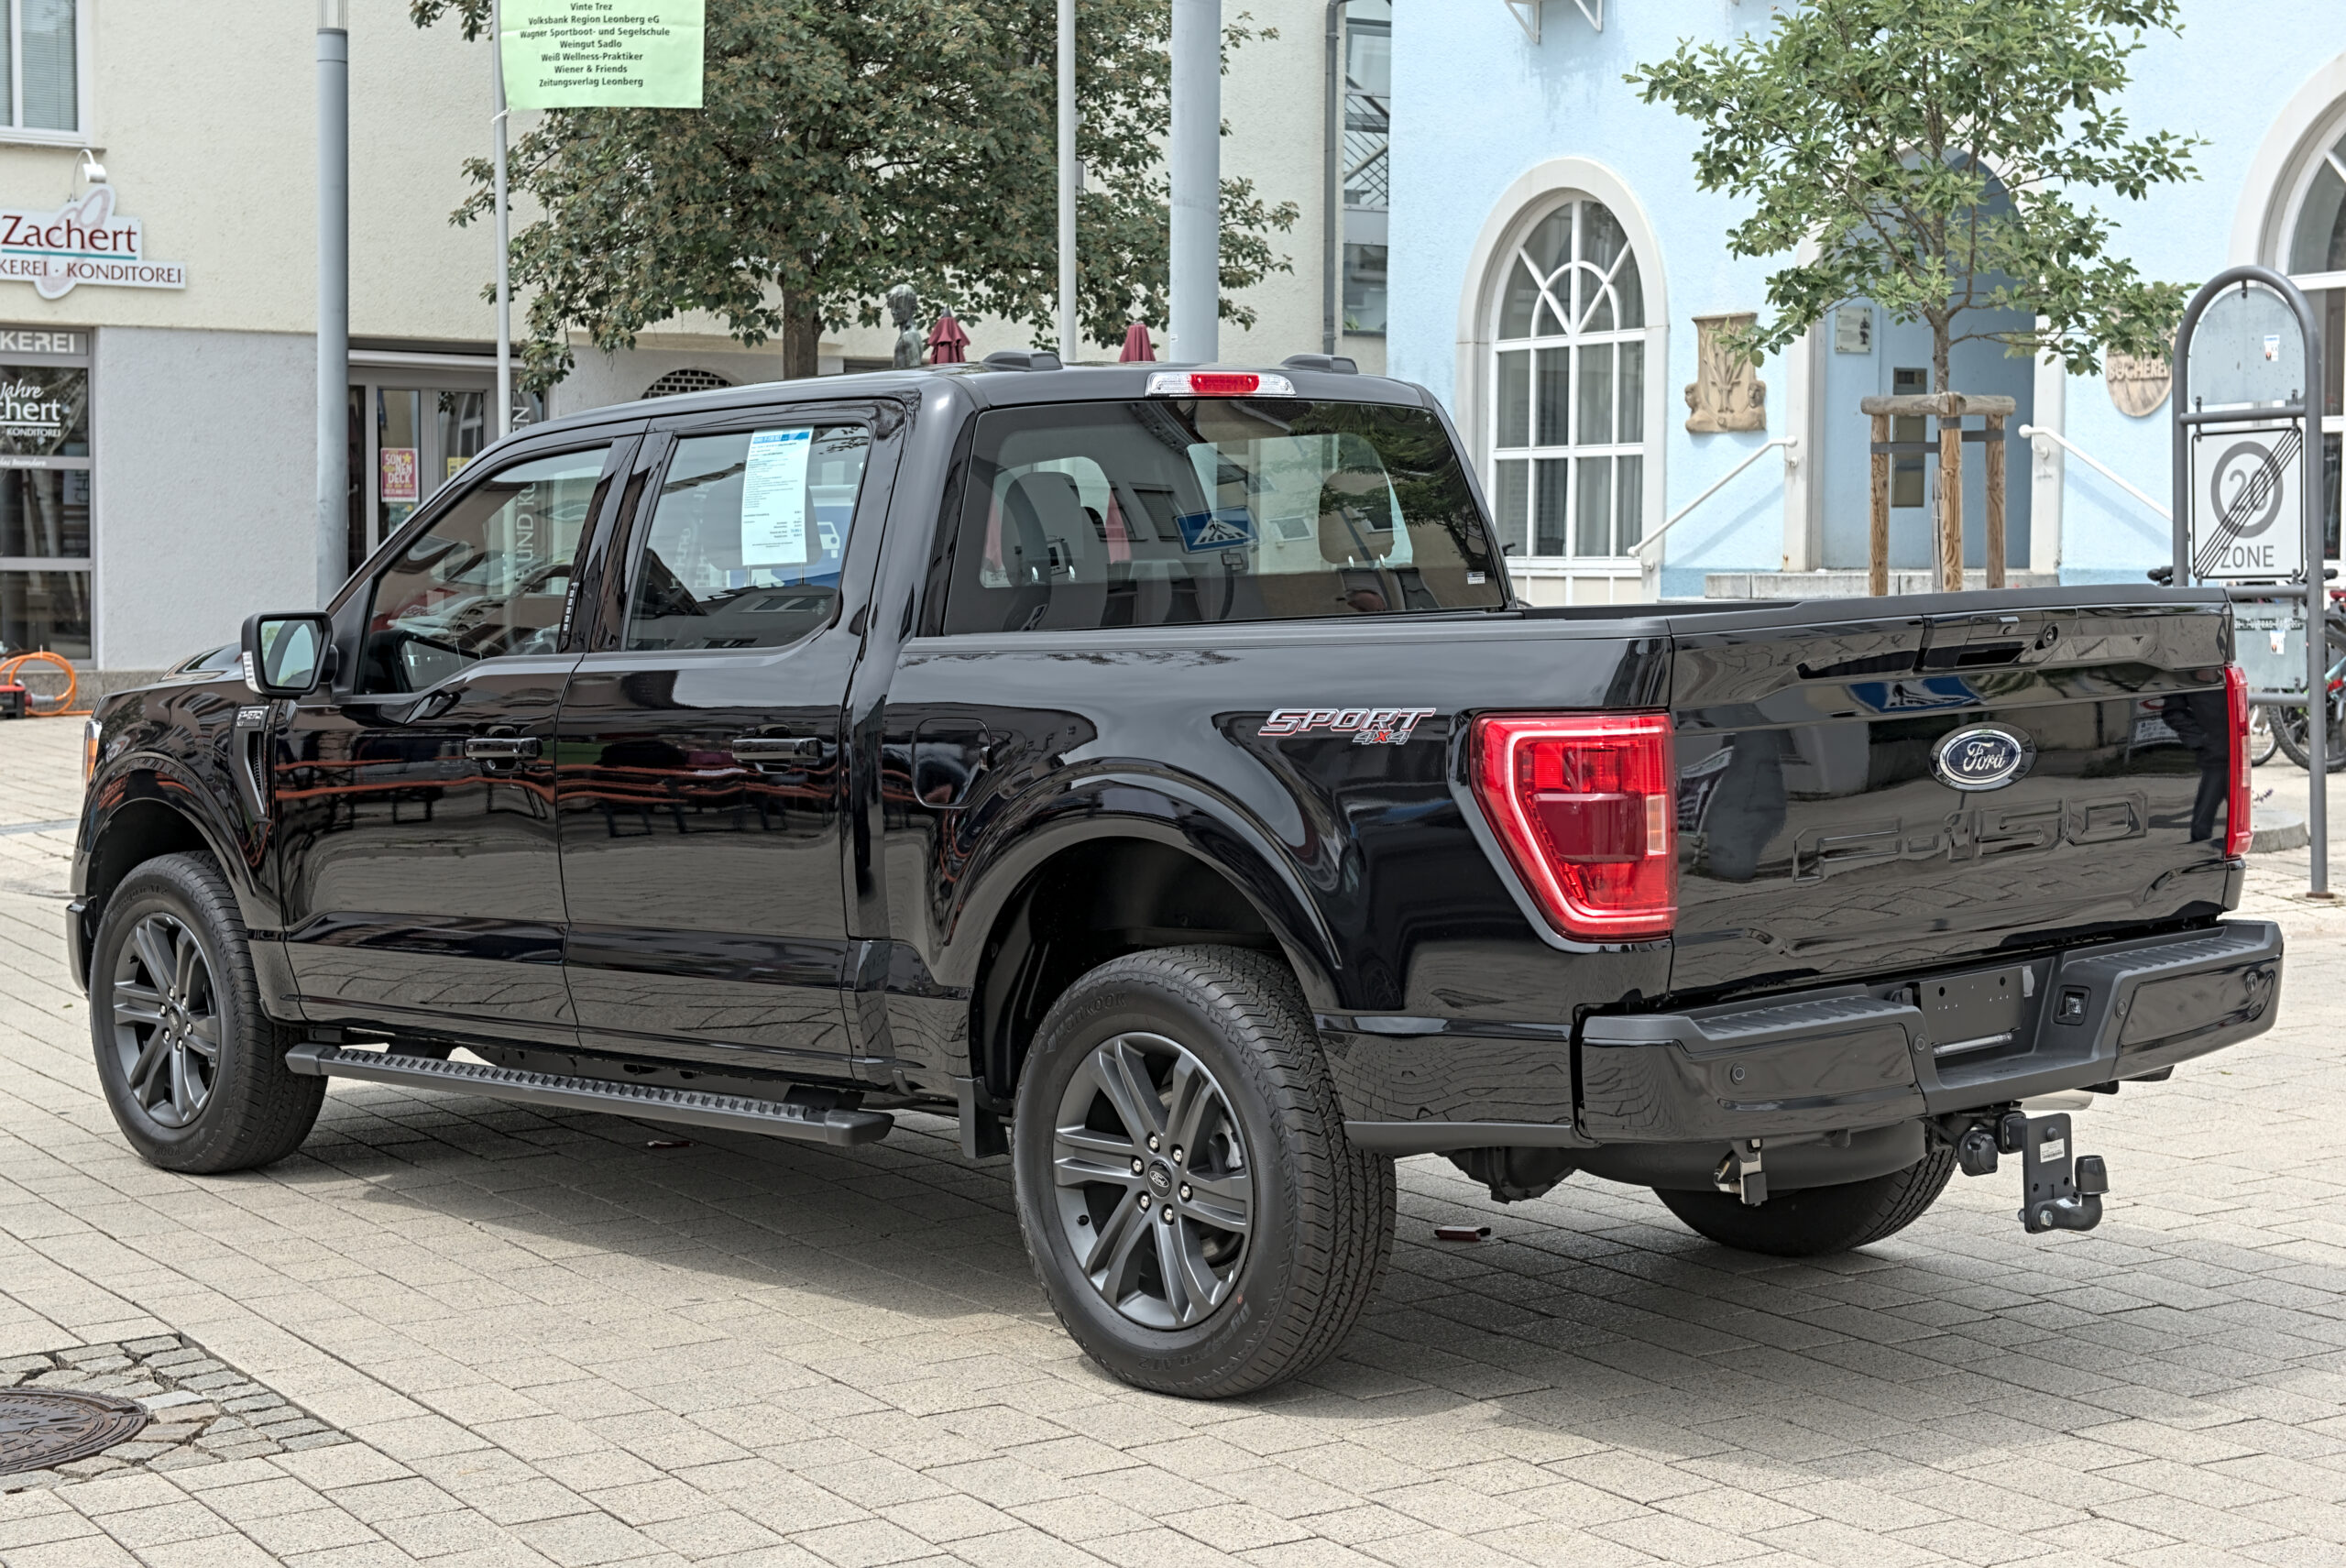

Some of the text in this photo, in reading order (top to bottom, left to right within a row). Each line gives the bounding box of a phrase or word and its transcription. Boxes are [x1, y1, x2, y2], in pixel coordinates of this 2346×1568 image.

[570, 3, 613, 11] Vinte Trez
[528, 15, 660, 26] Volksbank Region Leonberg eG
[521, 27, 671, 39] Wagner Sportboot- und Segelschule
[560, 39, 622, 50] Weingut Sadlo
[541, 51, 643, 61] Weiß Wellness-Praktiker
[554, 64, 628, 73] Wiener & Friends
[539, 77, 643, 88] Zeitungsverlag Leonberg
[1, 214, 137, 253] Zachert
[67, 262, 181, 283] KONDITOREI
[0, 331, 75, 353] KEREI
[0, 378, 44, 400] Jahre
[6, 427, 61, 437] KONDITOREI
[388, 473, 411, 484] DECK
[2229, 469, 2268, 511] 20
[516, 514, 534, 562] UND
[2220, 545, 2275, 568] ZONE
[1258, 707, 1436, 736] SPORT
[1963, 741, 2006, 772] Ford
[1793, 791, 2147, 882] F-150
